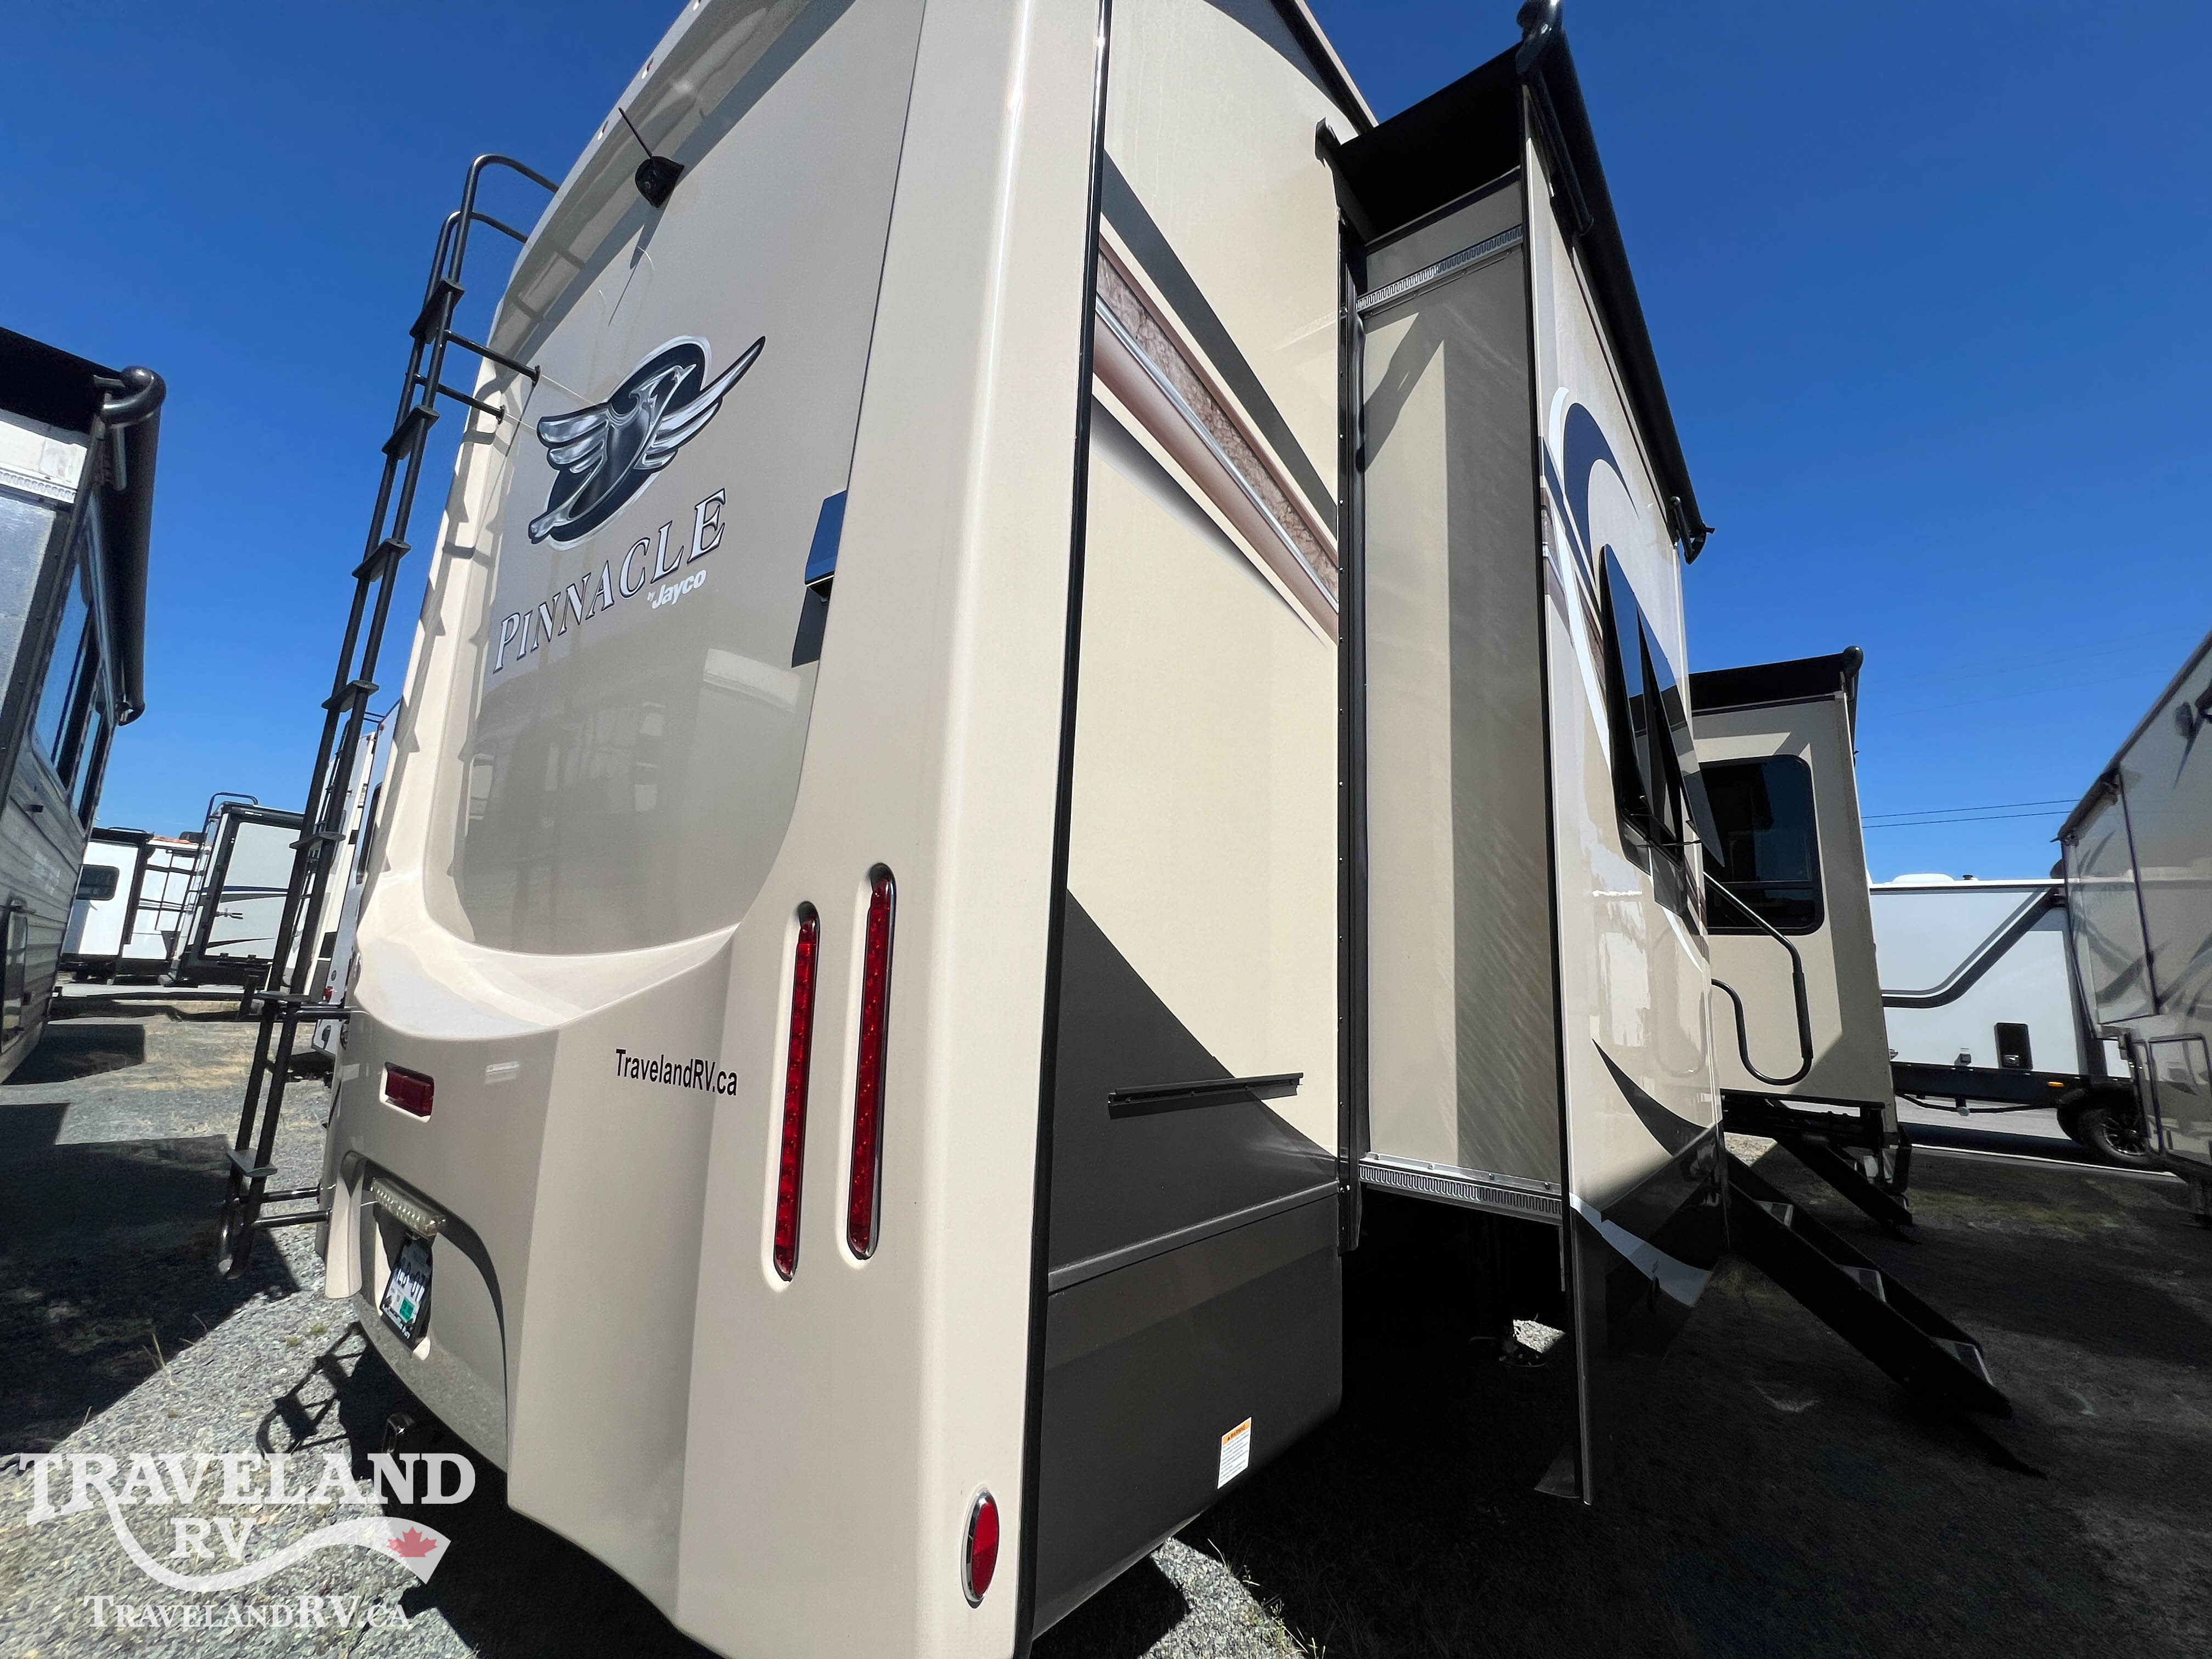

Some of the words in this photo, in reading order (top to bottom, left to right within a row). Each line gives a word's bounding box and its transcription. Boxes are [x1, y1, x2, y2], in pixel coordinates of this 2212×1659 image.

[493, 488, 726, 674] PINNACLE
[652, 569, 707, 609] Jayco
[616, 1048, 737, 1096] TravelandRV.ca
